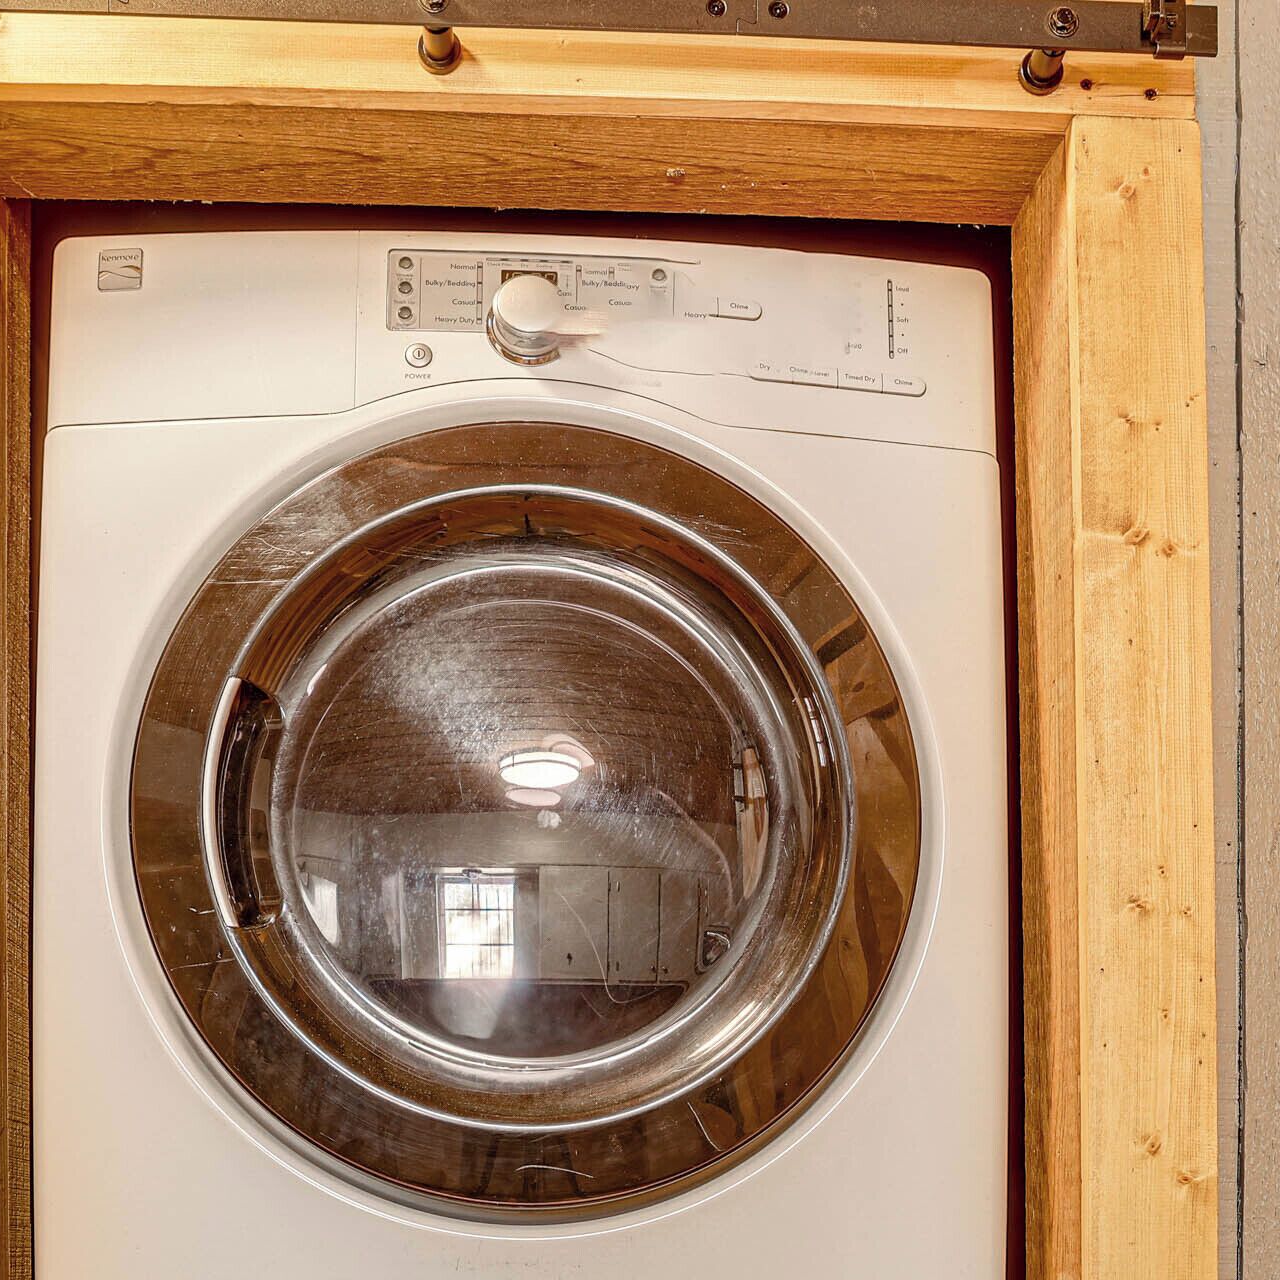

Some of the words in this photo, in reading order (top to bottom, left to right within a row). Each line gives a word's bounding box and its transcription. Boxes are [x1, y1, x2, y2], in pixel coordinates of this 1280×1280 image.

[101, 254, 139, 262] Kenmore
[425, 279, 476, 288] Bulky/Bedding
[451, 298, 476, 306] Casual
[730, 302, 749, 311] Chime
[684, 311, 708, 320] Heavy
[434, 315, 458, 324] Heavy
[459, 316, 475, 325] Duty
[897, 347, 909, 355] Off
[759, 363, 771, 371] Dry
[844, 373, 863, 381] Timed
[864, 375, 876, 384] Dry
[894, 378, 913, 386] Chime
